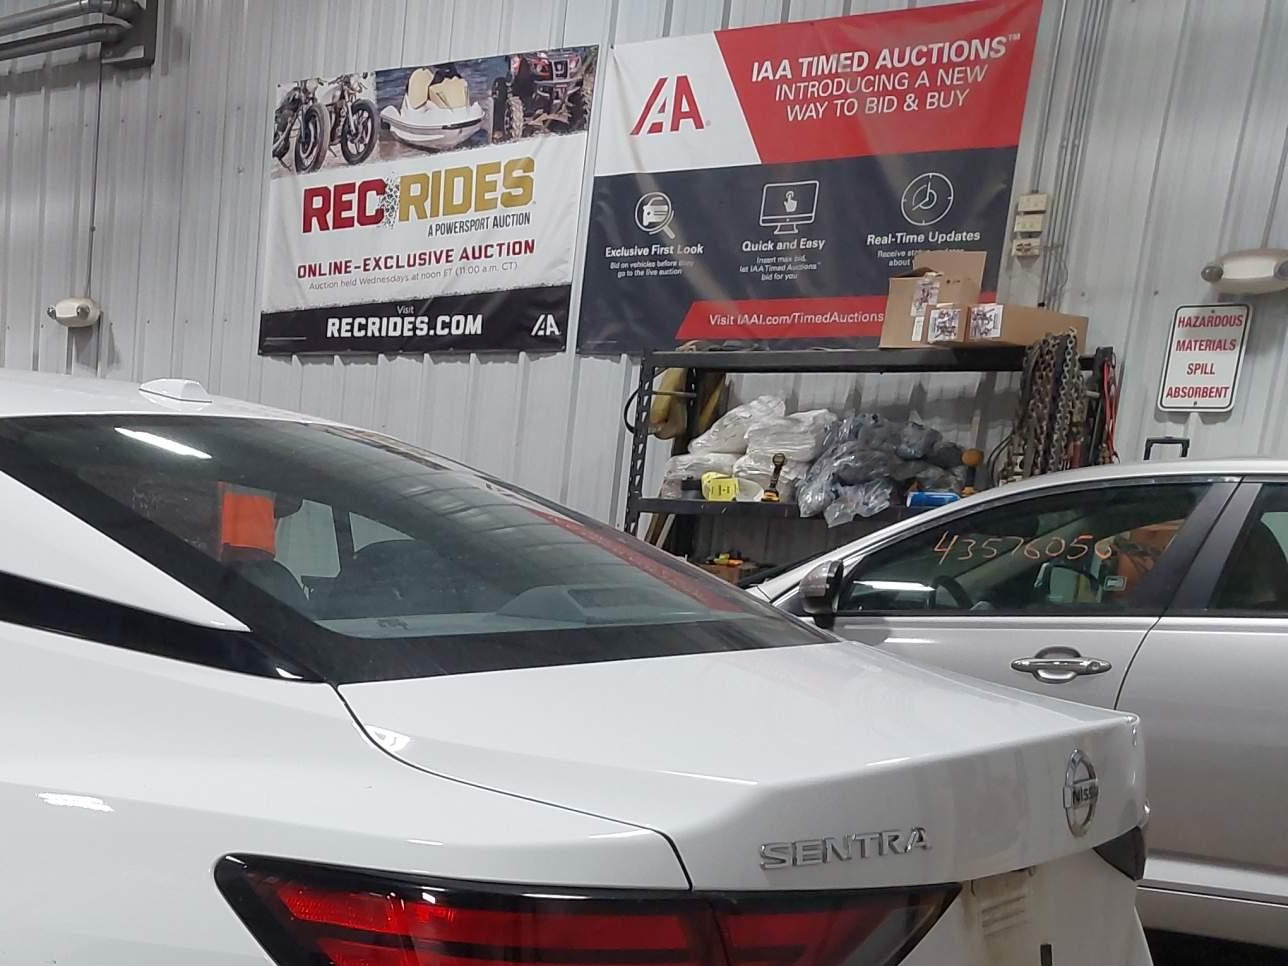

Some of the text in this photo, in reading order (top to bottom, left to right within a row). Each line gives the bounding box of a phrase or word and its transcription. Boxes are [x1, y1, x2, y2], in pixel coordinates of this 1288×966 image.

[751, 58, 792, 82] IAA
[798, 50, 869, 77] TIMED
[776, 64, 988, 101] INTRODUCING A NEW
[786, 88, 970, 122] WAY TO BID & BUY
[302, 156, 535, 234] REC RIDES
[428, 211, 531, 238] A POWERSPORT AUCTION
[742, 238, 826, 252] Quick and Easy
[866, 230, 980, 246] Real-Time Updates
[605, 243, 704, 258] Exclusive First Look
[877, 249, 906, 258] Receive
[297, 239, 535, 279] ONLINE-EXCLUSIVE AUCTION
[888, 258, 911, 266] about
[750, 264, 764, 272] IAA
[765, 264, 786, 272] Timed
[309, 280, 339, 290] Auction
[341, 278, 357, 288] held
[358, 273, 409, 286] Wednesdays
[421, 271, 441, 280] noon
[397, 304, 414, 315] Visit
[326, 314, 483, 338] RECRIDES.COM
[709, 311, 885, 326] Visit IAAI.com/TimedAuctions
[1177, 314, 1244, 328] HAZARDOUS
[1175, 338, 1238, 352] MATERIALS
[1186, 362, 1216, 375] SPILL
[1166, 386, 1230, 398] ABSORBENT
[1072, 783, 1100, 805] NISS
[760, 826, 932, 871] SENTRA
